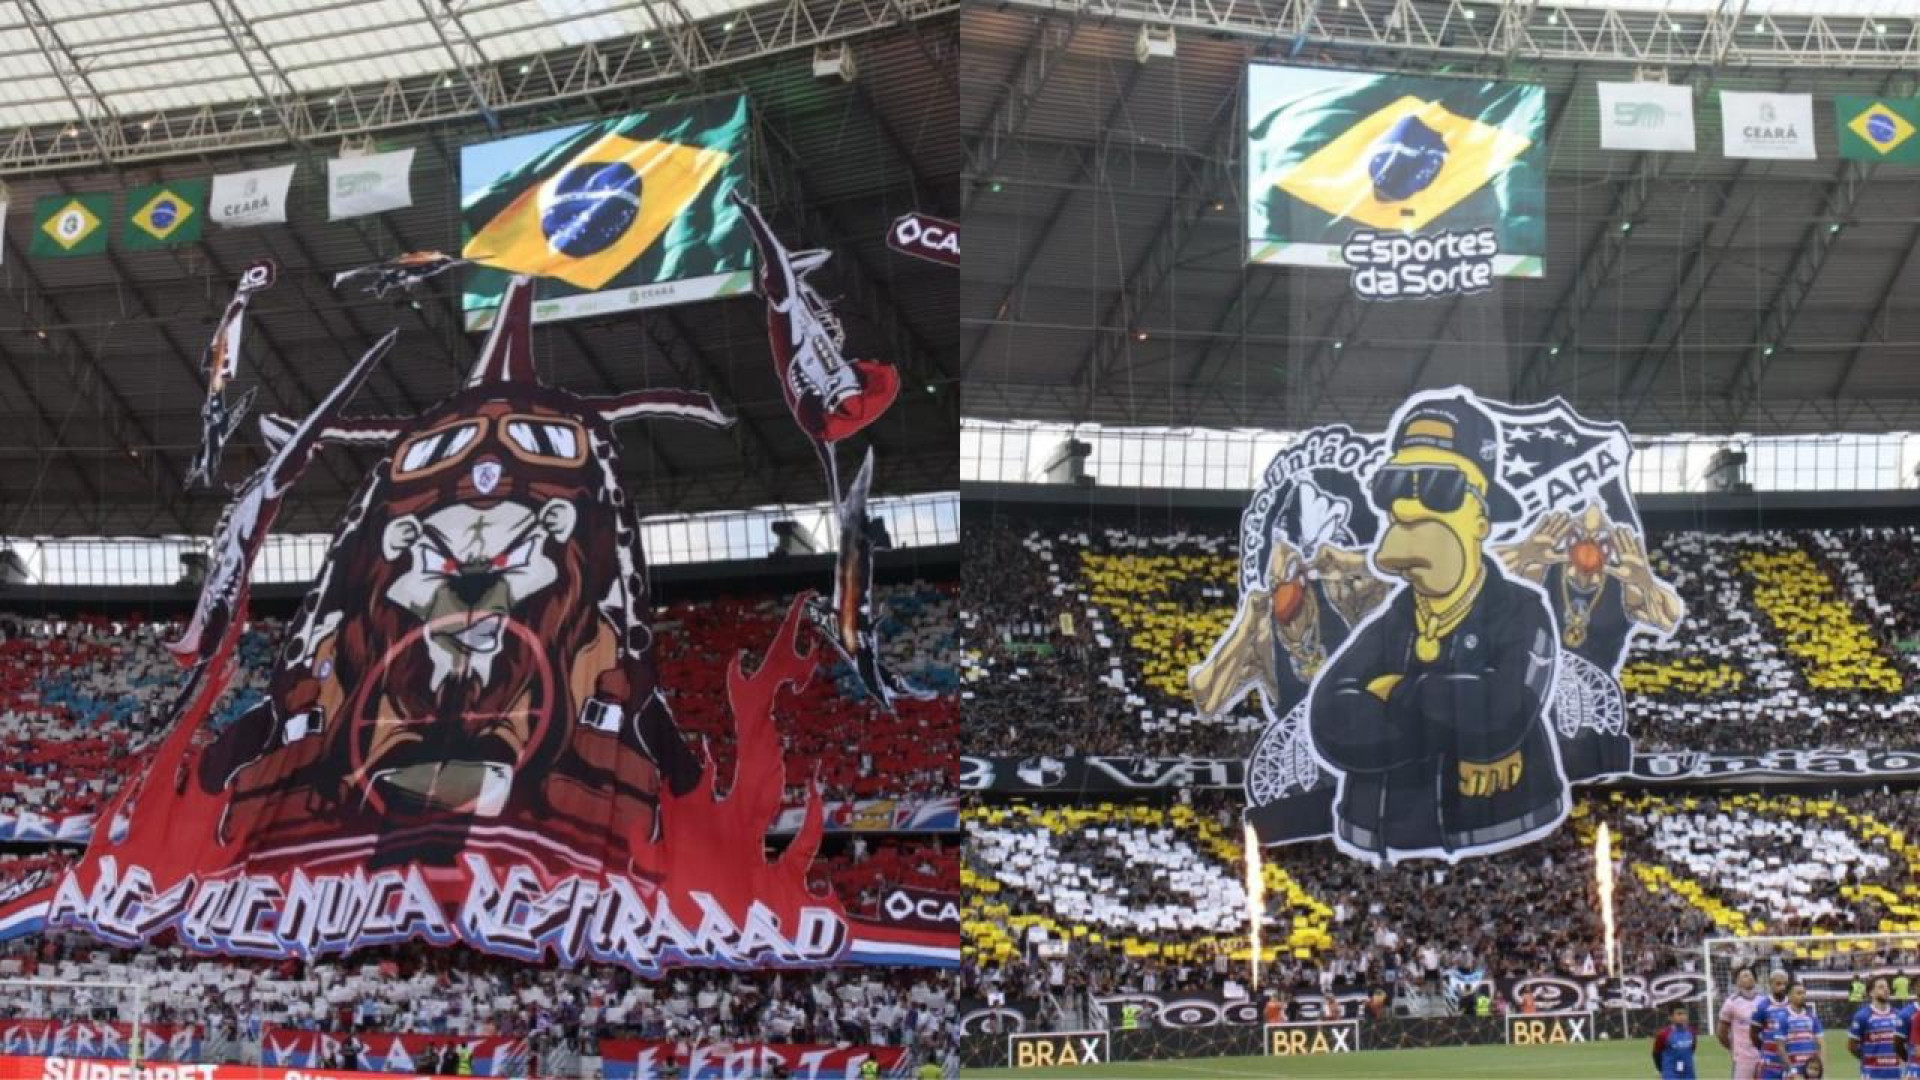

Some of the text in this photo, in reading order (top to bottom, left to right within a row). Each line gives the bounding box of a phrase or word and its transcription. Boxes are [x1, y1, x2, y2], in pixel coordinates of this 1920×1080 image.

[1742, 123, 1798, 138] CEARÁ
[1344, 231, 1497, 270] Esportes
[1355, 260, 1491, 295] da Sorte
[185, 869, 285, 954] QUE
[278, 864, 454, 962] NUNCA
[1272, 1028, 1350, 1056] BRAX
[1516, 1018, 1586, 1044] BRAX
[1017, 1037, 1100, 1067] BRAX
